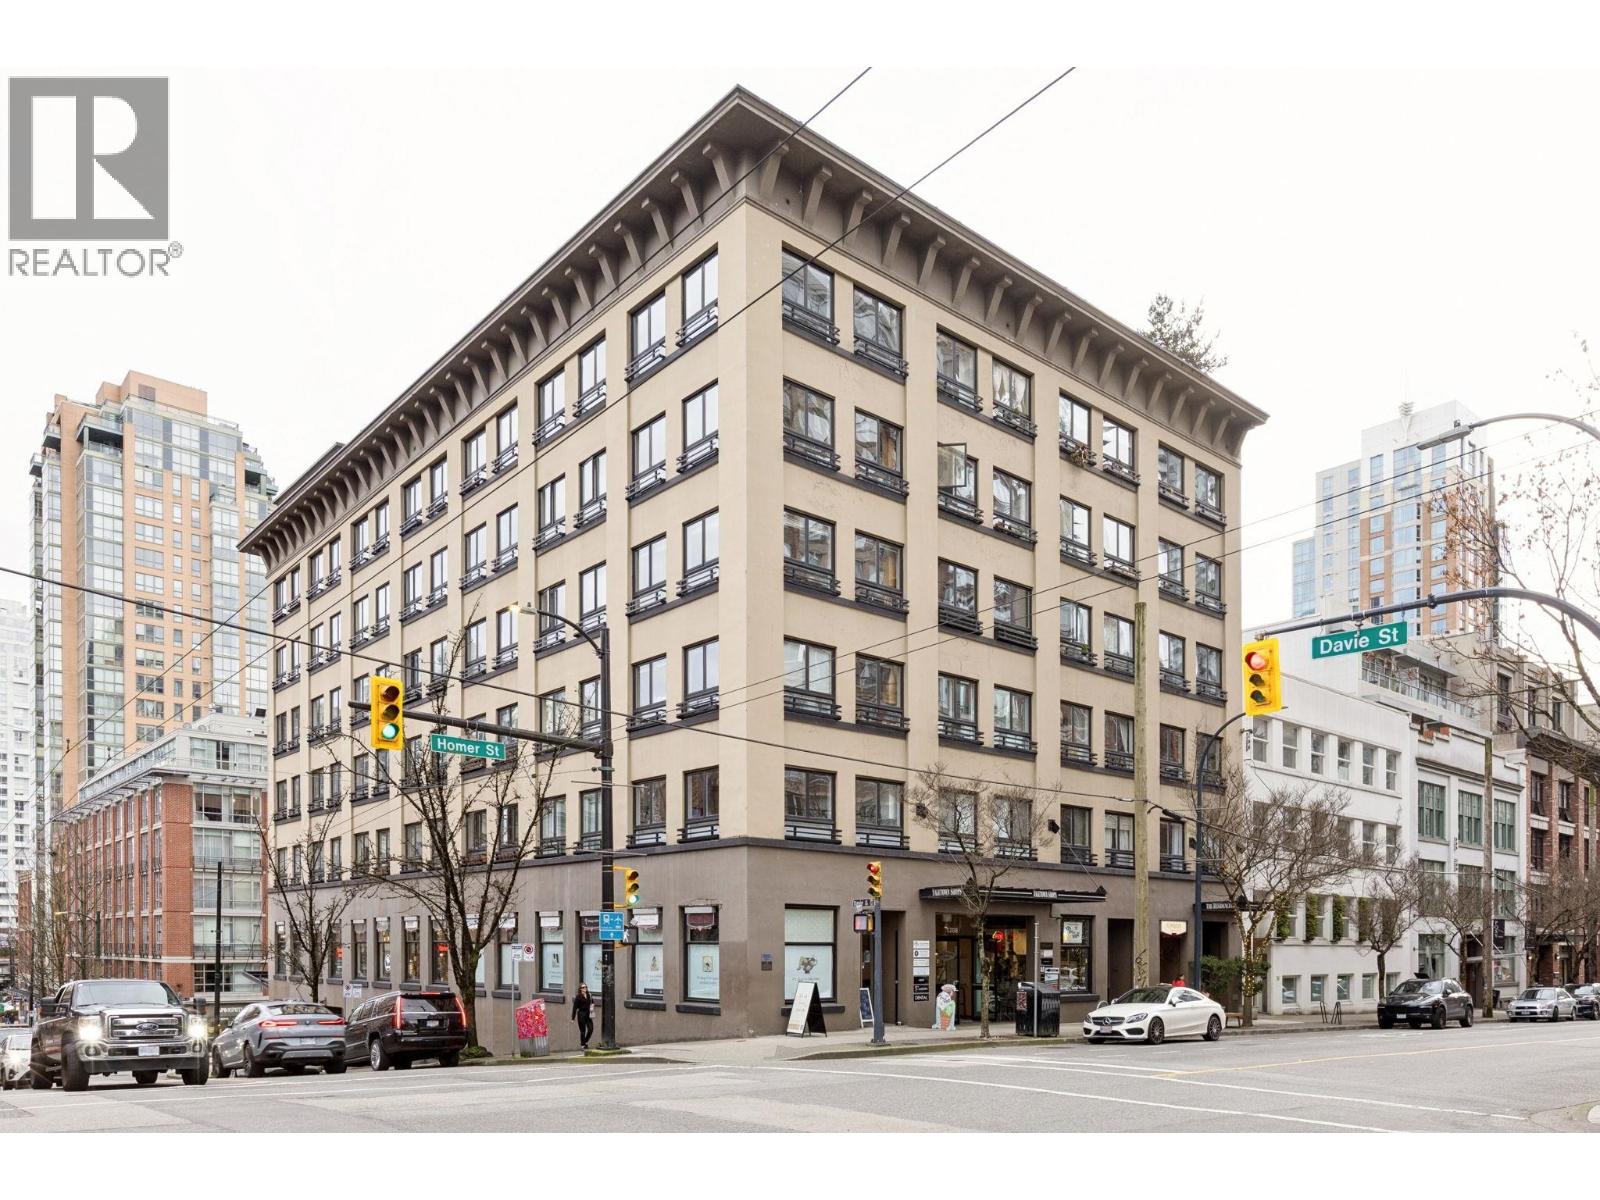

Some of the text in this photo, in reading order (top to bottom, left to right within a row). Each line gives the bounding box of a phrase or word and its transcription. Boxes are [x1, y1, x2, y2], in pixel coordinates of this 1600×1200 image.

[1320, 627, 1399, 655] Davie St
[437, 738, 500, 757] Homer St
